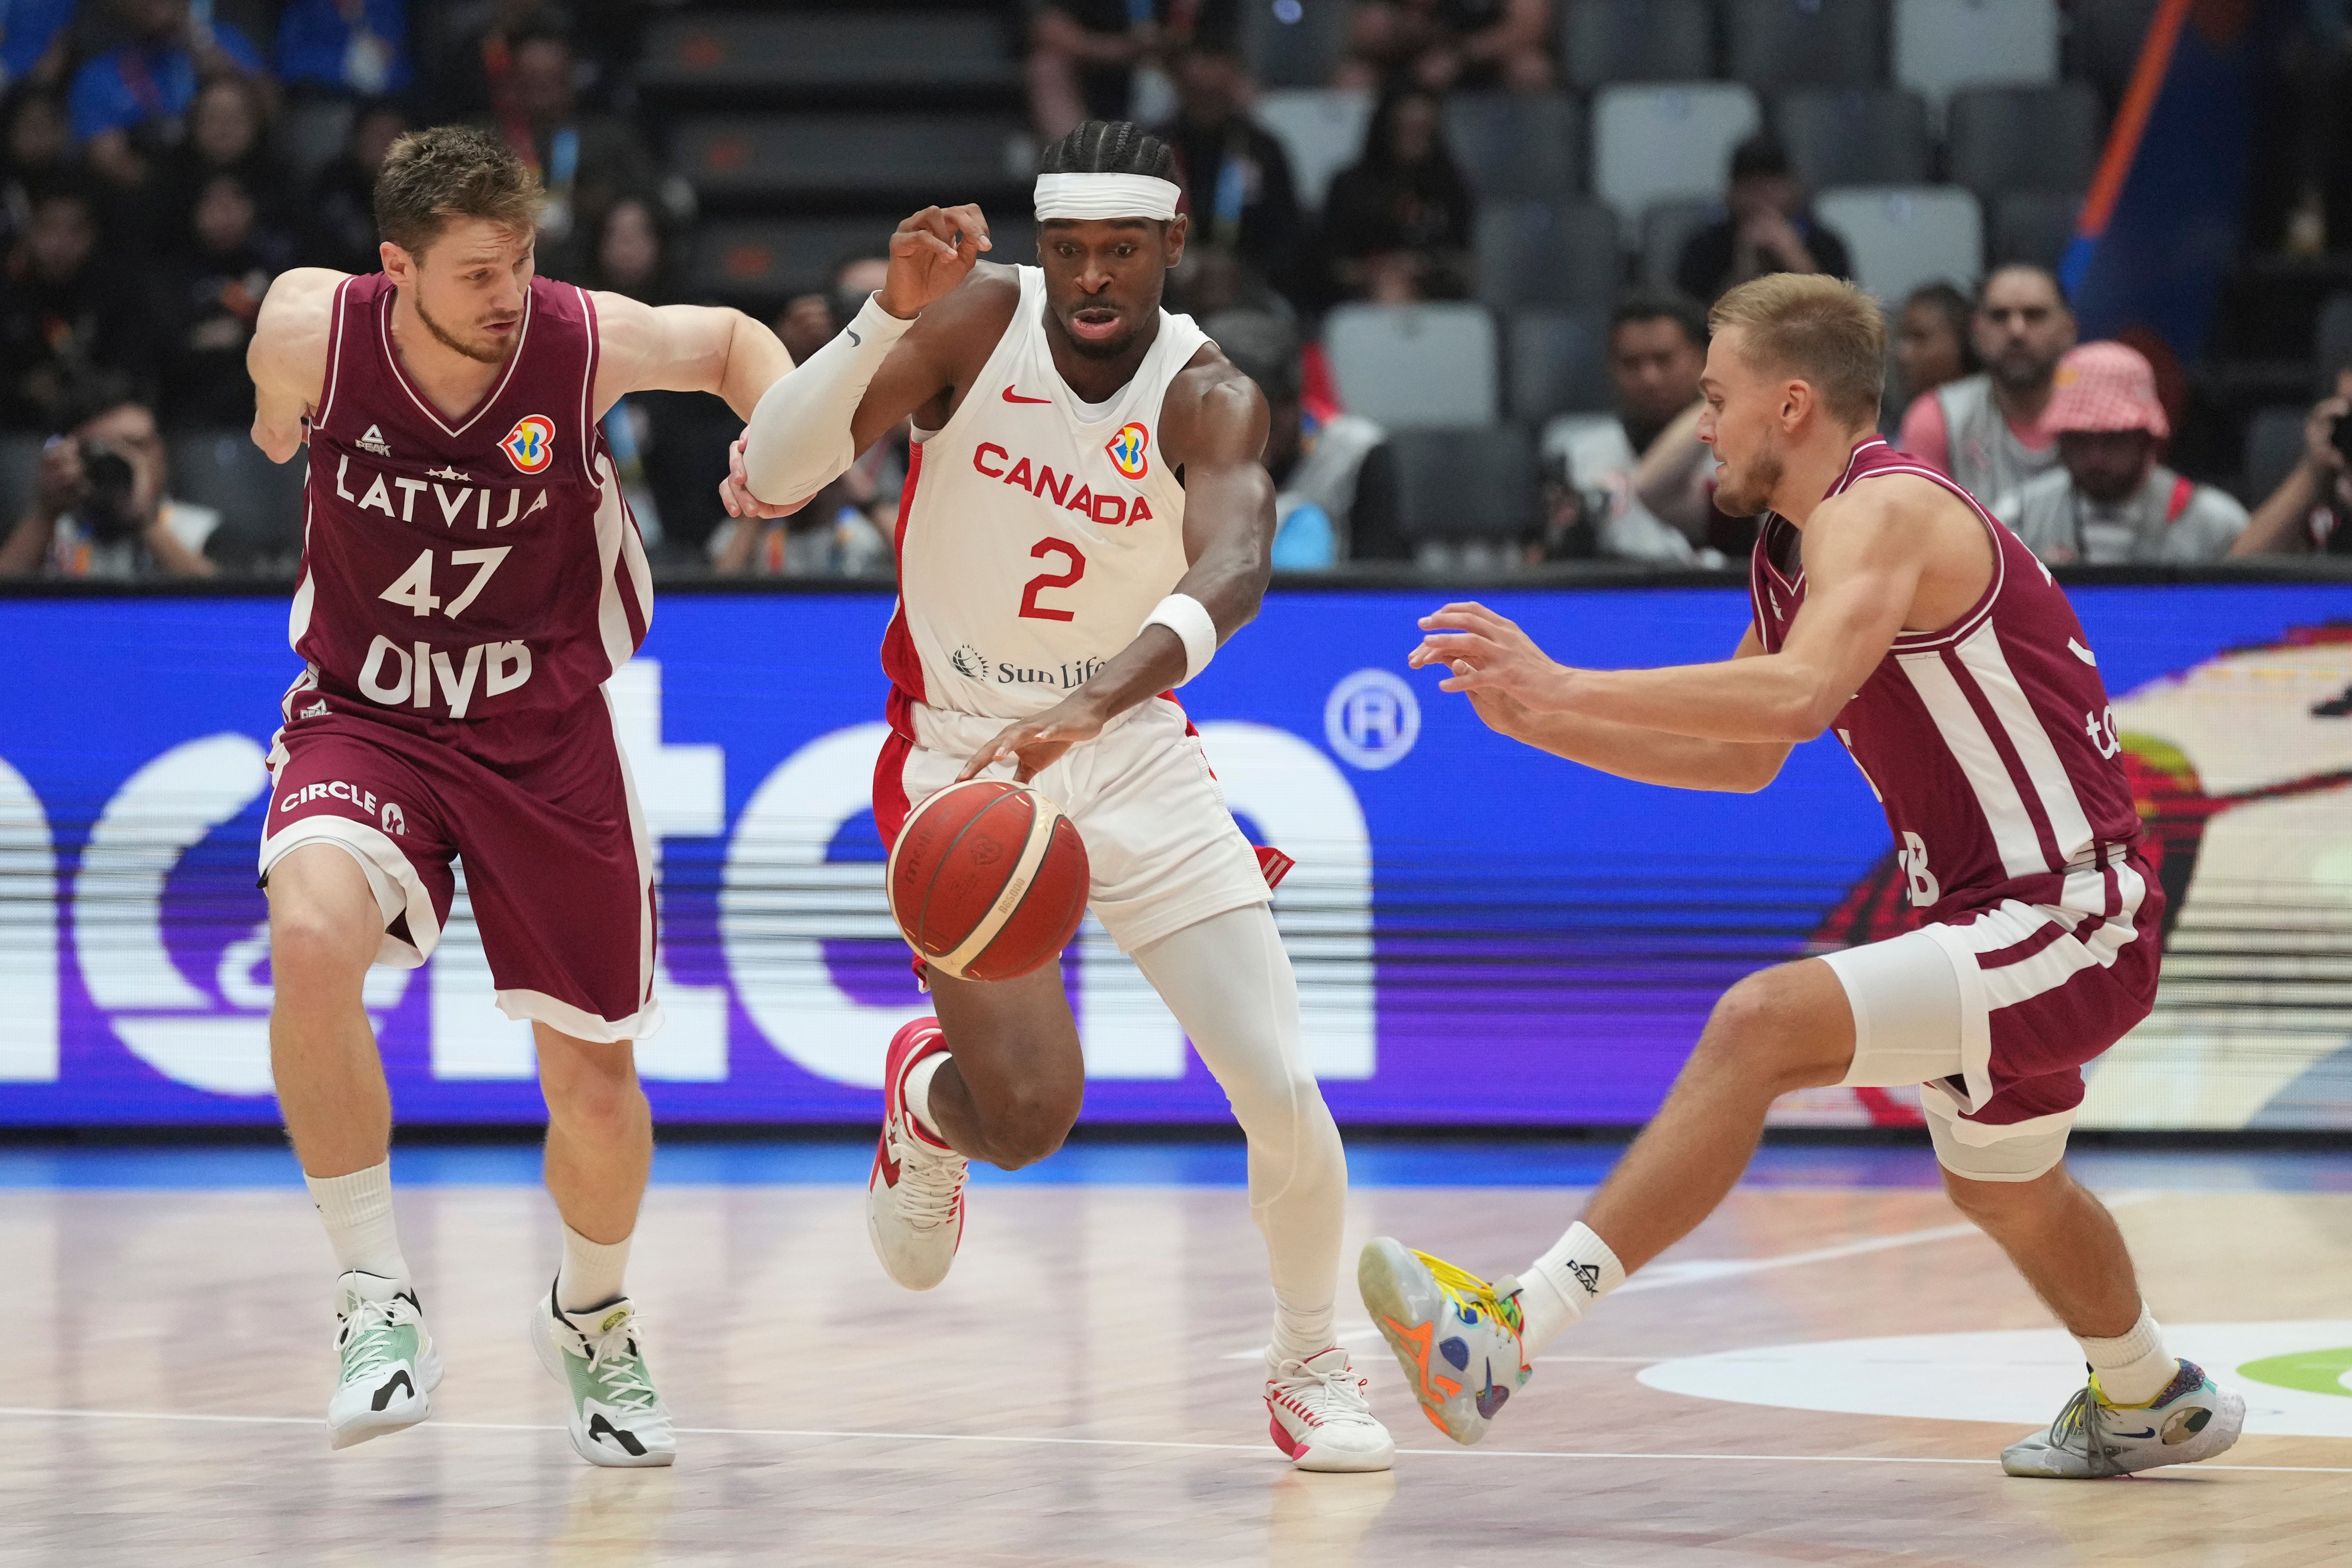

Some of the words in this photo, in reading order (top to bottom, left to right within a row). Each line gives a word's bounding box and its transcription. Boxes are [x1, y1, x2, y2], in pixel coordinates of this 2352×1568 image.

[355, 439, 391, 457] PEAK
[336, 454, 548, 529] LATVIJA
[973, 442, 1153, 527] CANADA
[378, 546, 513, 620] 47
[1018, 536, 1086, 622] 2
[998, 663, 1055, 684] Sun
[281, 780, 377, 816] CIRCLE
[1566, 1260, 1599, 1298] PEAK
